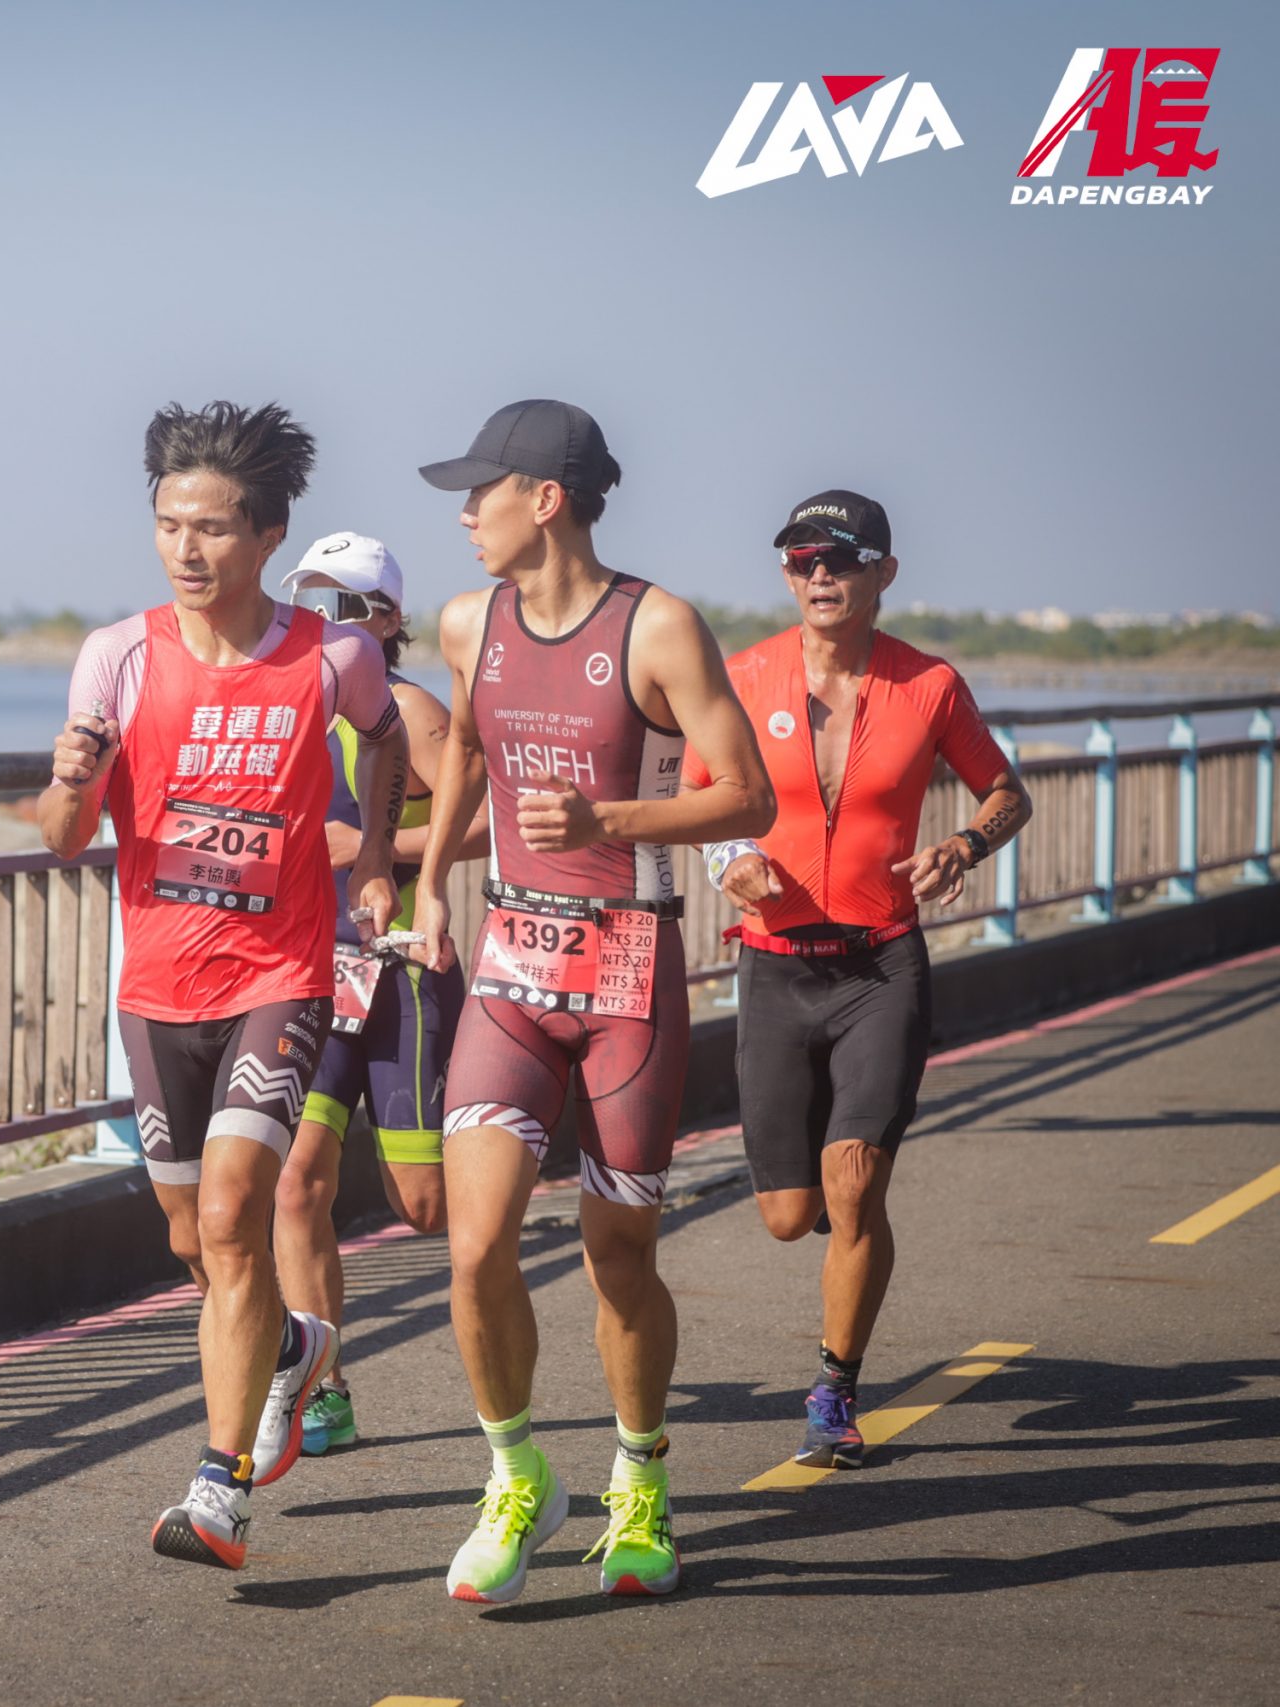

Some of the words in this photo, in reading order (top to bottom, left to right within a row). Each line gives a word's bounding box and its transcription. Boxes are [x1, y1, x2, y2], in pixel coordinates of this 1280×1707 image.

[189, 705, 297, 739] 愛運動
[494, 708, 545, 722] UNIVERSITY
[547, 713, 561, 723] OF
[564, 714, 593, 728] TAIPEI
[506, 721, 579, 738] TRIATHLON
[501, 741, 596, 785] HSIEH
[175, 819, 269, 860] 2204
[605, 911, 633, 925] NT$
[637, 913, 653, 926] 20
[502, 917, 586, 956] 1392
[603, 932, 631, 946] NT$
[635, 935, 652, 947] 20
[602, 953, 630, 967] NT$
[634, 956, 651, 968] 20
[600, 974, 628, 989] NT$
[632, 977, 649, 990] 20
[598, 996, 626, 1010] NT$
[630, 998, 647, 1011] 20
